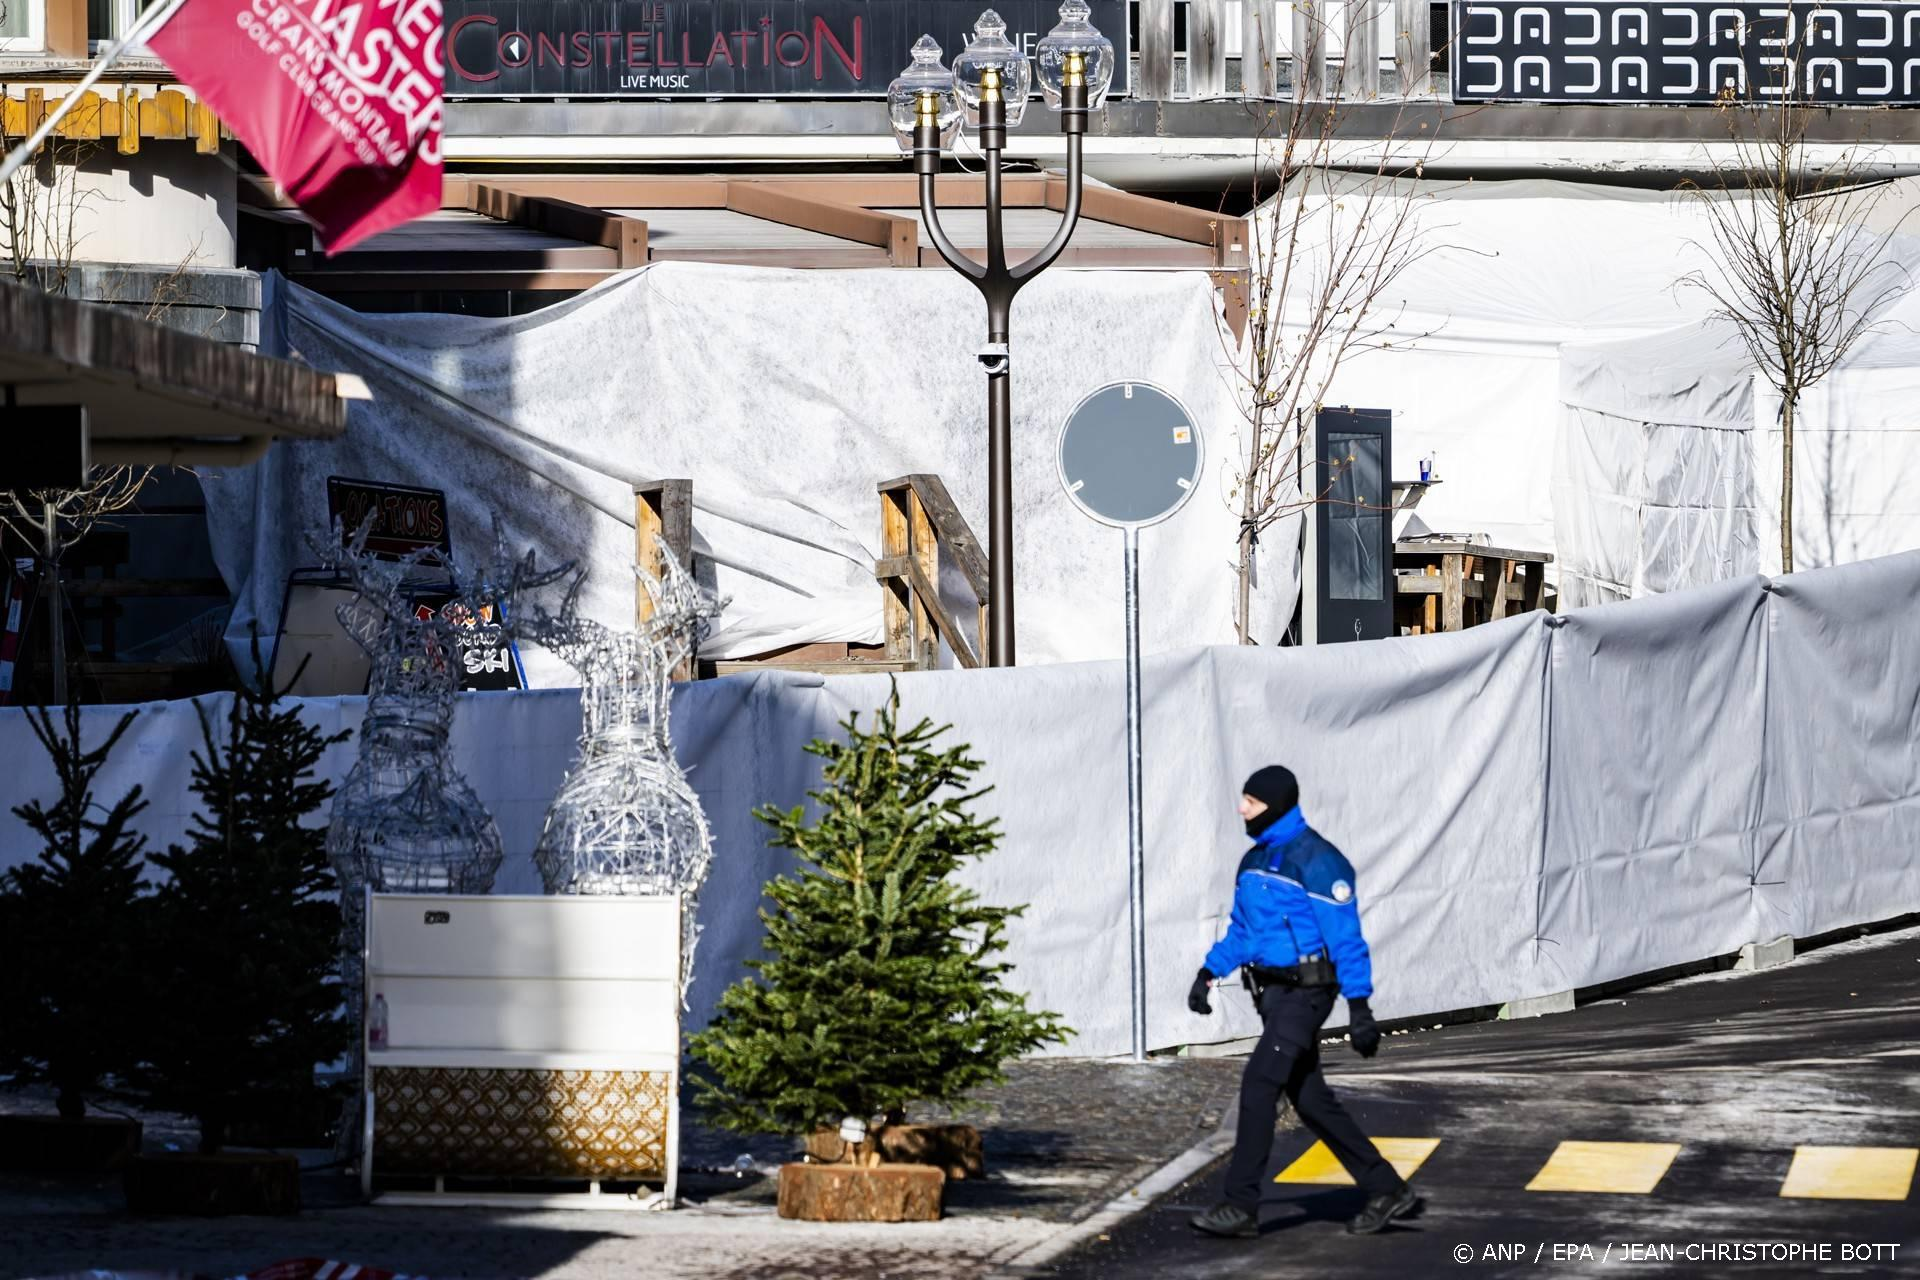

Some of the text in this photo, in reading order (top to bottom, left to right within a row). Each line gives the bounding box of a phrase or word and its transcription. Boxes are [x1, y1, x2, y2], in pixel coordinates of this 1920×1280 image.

[237, 10, 284, 56] GOLF
[279, 53, 319, 98] CLUB
[620, 74, 690, 88] LIVE MUSIC
[463, 647, 510, 674] SKI
